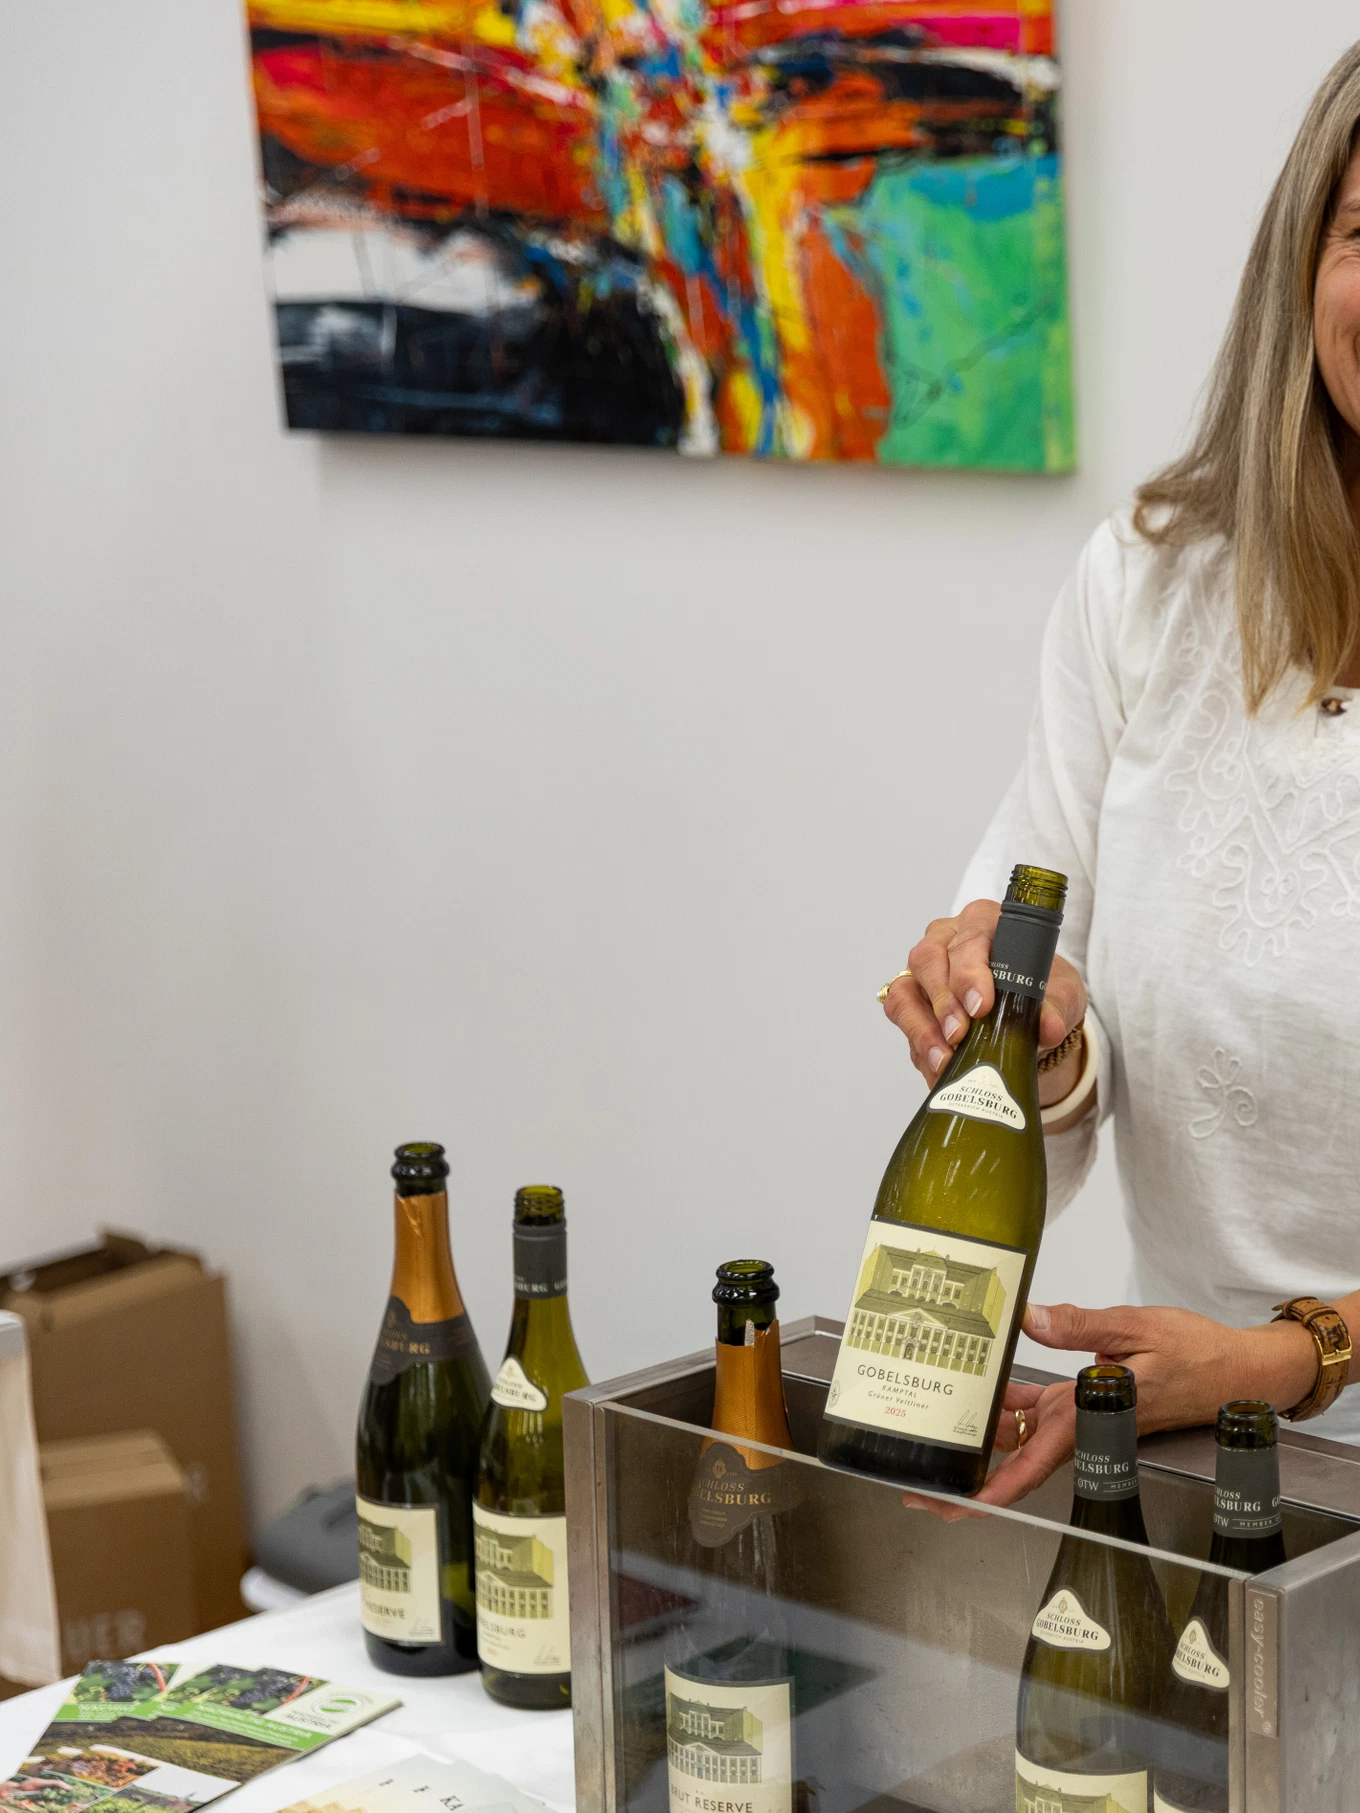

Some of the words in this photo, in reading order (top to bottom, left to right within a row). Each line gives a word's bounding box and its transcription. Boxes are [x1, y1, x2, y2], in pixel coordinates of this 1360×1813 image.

[960, 1086, 1004, 1101] SCHLOSS
[939, 1093, 1018, 1119] GOBELSBURG
[857, 1364, 954, 1396] GOBELSBURG
[867, 1390, 893, 1402] Grüner
[895, 1398, 930, 1410] Veltliner
[881, 1384, 918, 1399] KAMPTAL
[884, 1406, 907, 1418] 2025
[1047, 1612, 1082, 1627] SCHLOSS
[1250, 1599, 1268, 1719] easy-cooler
[670, 1783, 690, 1803] BRUT
[695, 1796, 753, 1813] RESERVE
